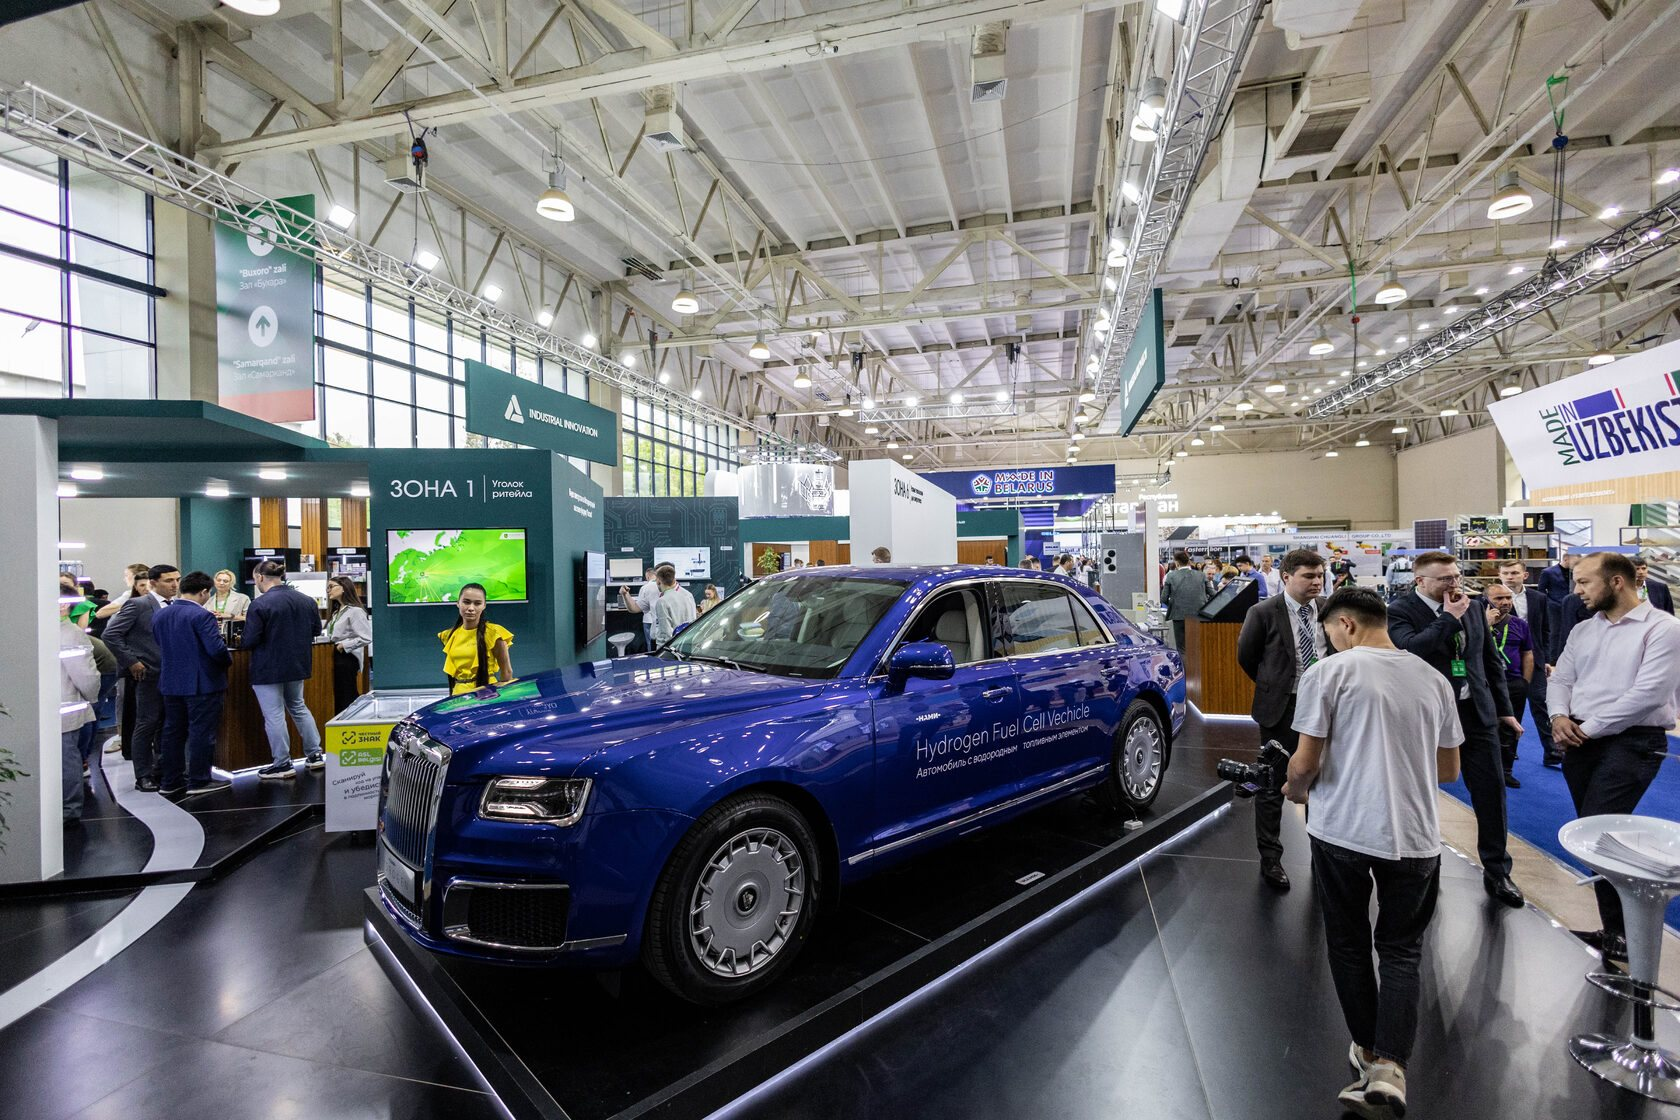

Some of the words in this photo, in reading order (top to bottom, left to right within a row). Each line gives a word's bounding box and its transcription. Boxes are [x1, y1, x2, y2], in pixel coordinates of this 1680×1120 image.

[1557, 401, 1578, 423] IN
[529, 408, 563, 428] INDUSTRIAL
[563, 419, 599, 438] INNOVATION
[1539, 405, 1581, 466] MADE
[995, 472, 1036, 482] MADE
[1039, 470, 1054, 481] IN
[390, 480, 458, 498] ЗОНА
[466, 480, 474, 498] 1
[492, 480, 524, 489] Уголок
[994, 481, 1054, 494] BELARUS
[492, 489, 533, 499] ритейла
[358, 735, 381, 743] ЗНАК
[916, 730, 990, 763] Hydrogen
[992, 718, 1020, 742] Fuel
[1022, 712, 1046, 733] Cell
[1047, 703, 1090, 727] Vechicle
[915, 759, 967, 780] Автомобиль
[973, 745, 1018, 764] водородным
[1022, 734, 1058, 750] топливным
[1057, 725, 1089, 741] элементом
[332, 771, 366, 786] Сканируй
